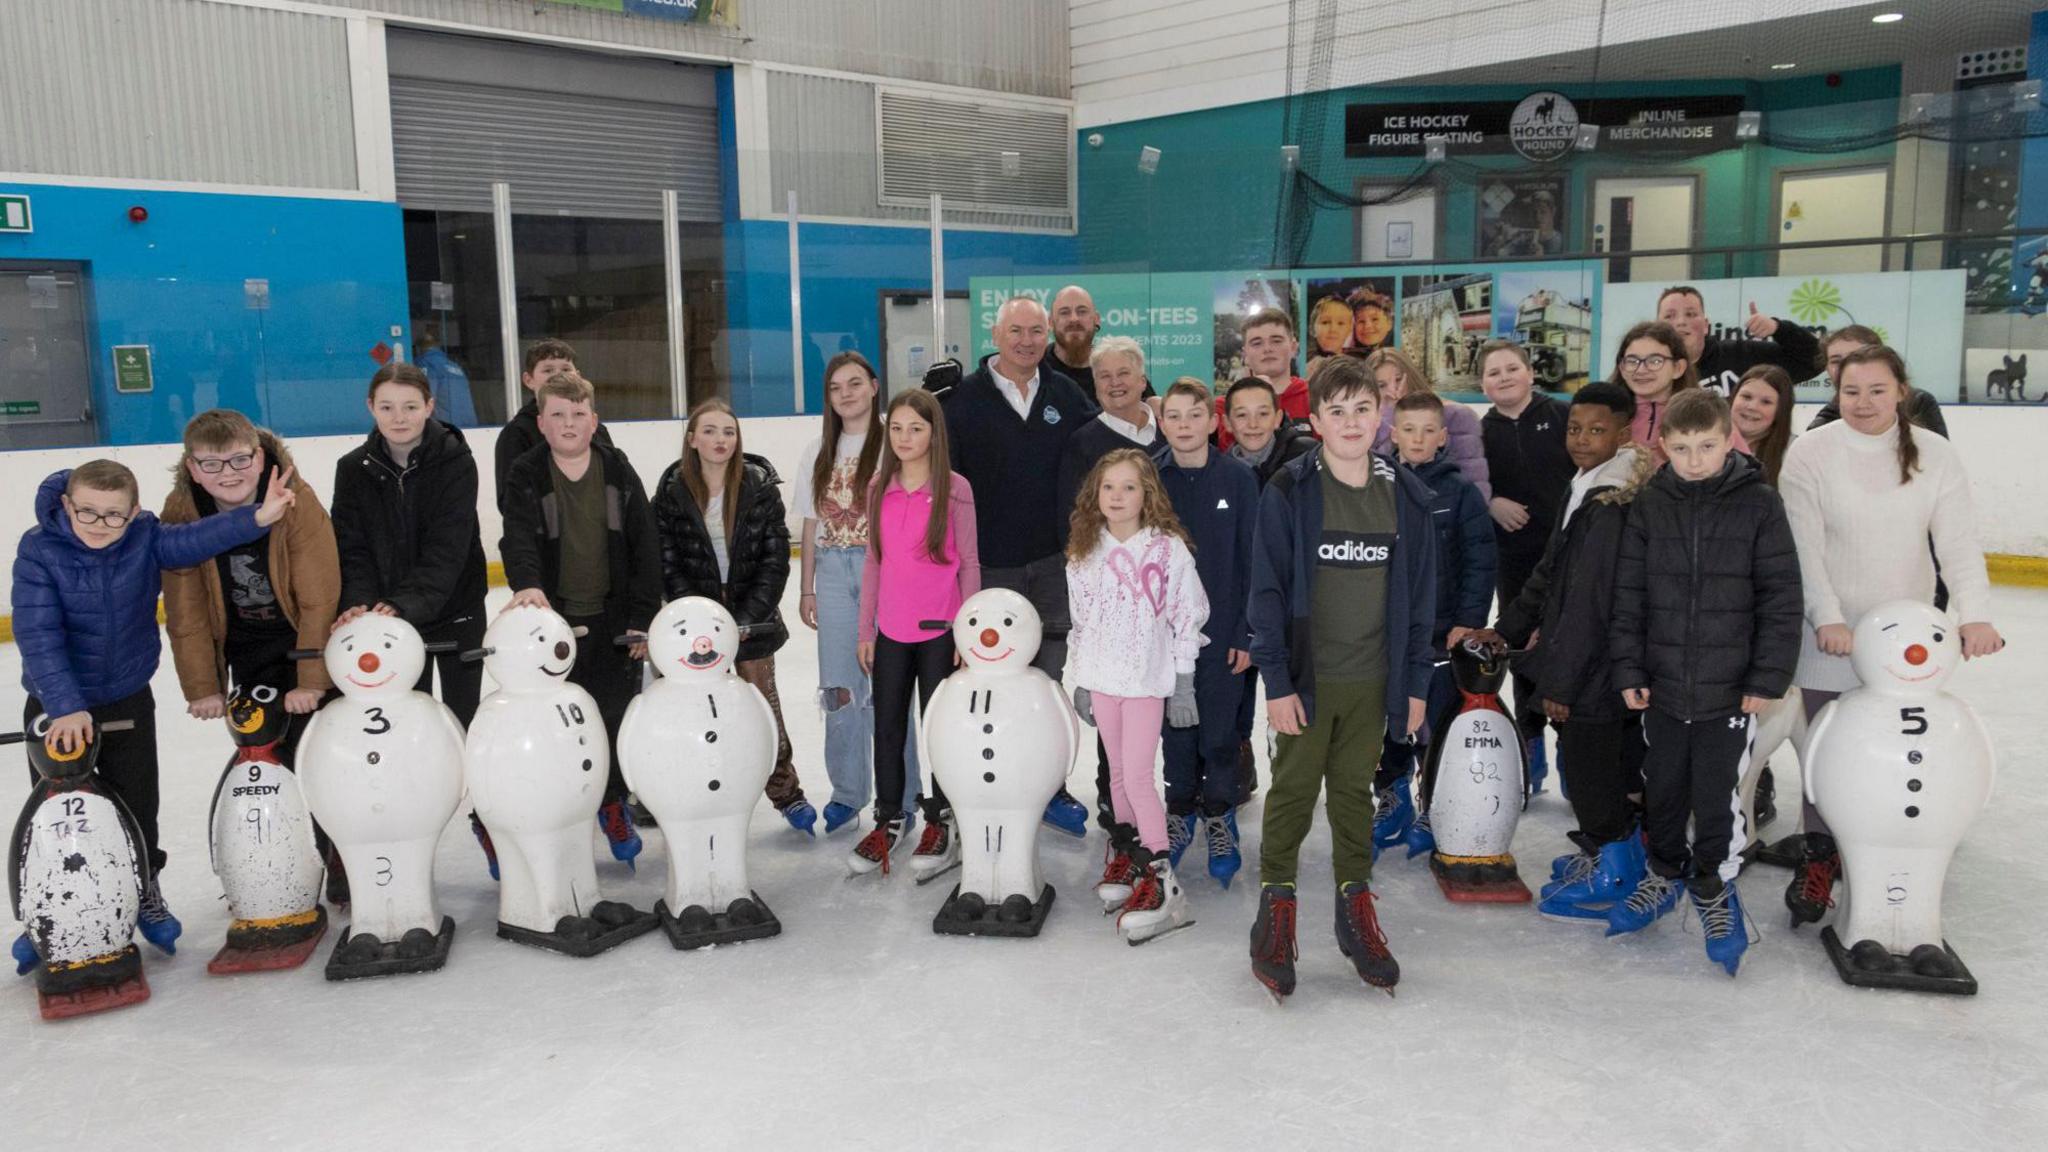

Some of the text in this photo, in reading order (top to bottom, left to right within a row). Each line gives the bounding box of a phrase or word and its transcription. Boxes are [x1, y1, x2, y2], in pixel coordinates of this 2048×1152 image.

[1384, 115, 1469, 128] ICE HOCKEY
[1639, 110, 1686, 123] INLINE
[1514, 126, 1574, 137] HOCKEY
[1610, 126, 1713, 140] MERCHANDISE
[1369, 133, 1420, 146] FIGURE
[1522, 140, 1565, 150] HOUND
[1171, 334, 1202, 346] 2023
[1318, 540, 1389, 561] adidas
[363, 707, 391, 734] 3
[555, 702, 586, 728] 10
[1900, 706, 1929, 735] 5
[1472, 720, 1491, 733] 82
[1465, 737, 1504, 748] EMMA
[248, 765, 262, 782] 9
[1469, 761, 1502, 784] 82
[232, 783, 281, 797] SPEEDY
[62, 797, 86, 816] 12
[50, 818, 93, 840] TAZ
[375, 856, 393, 887] 3
